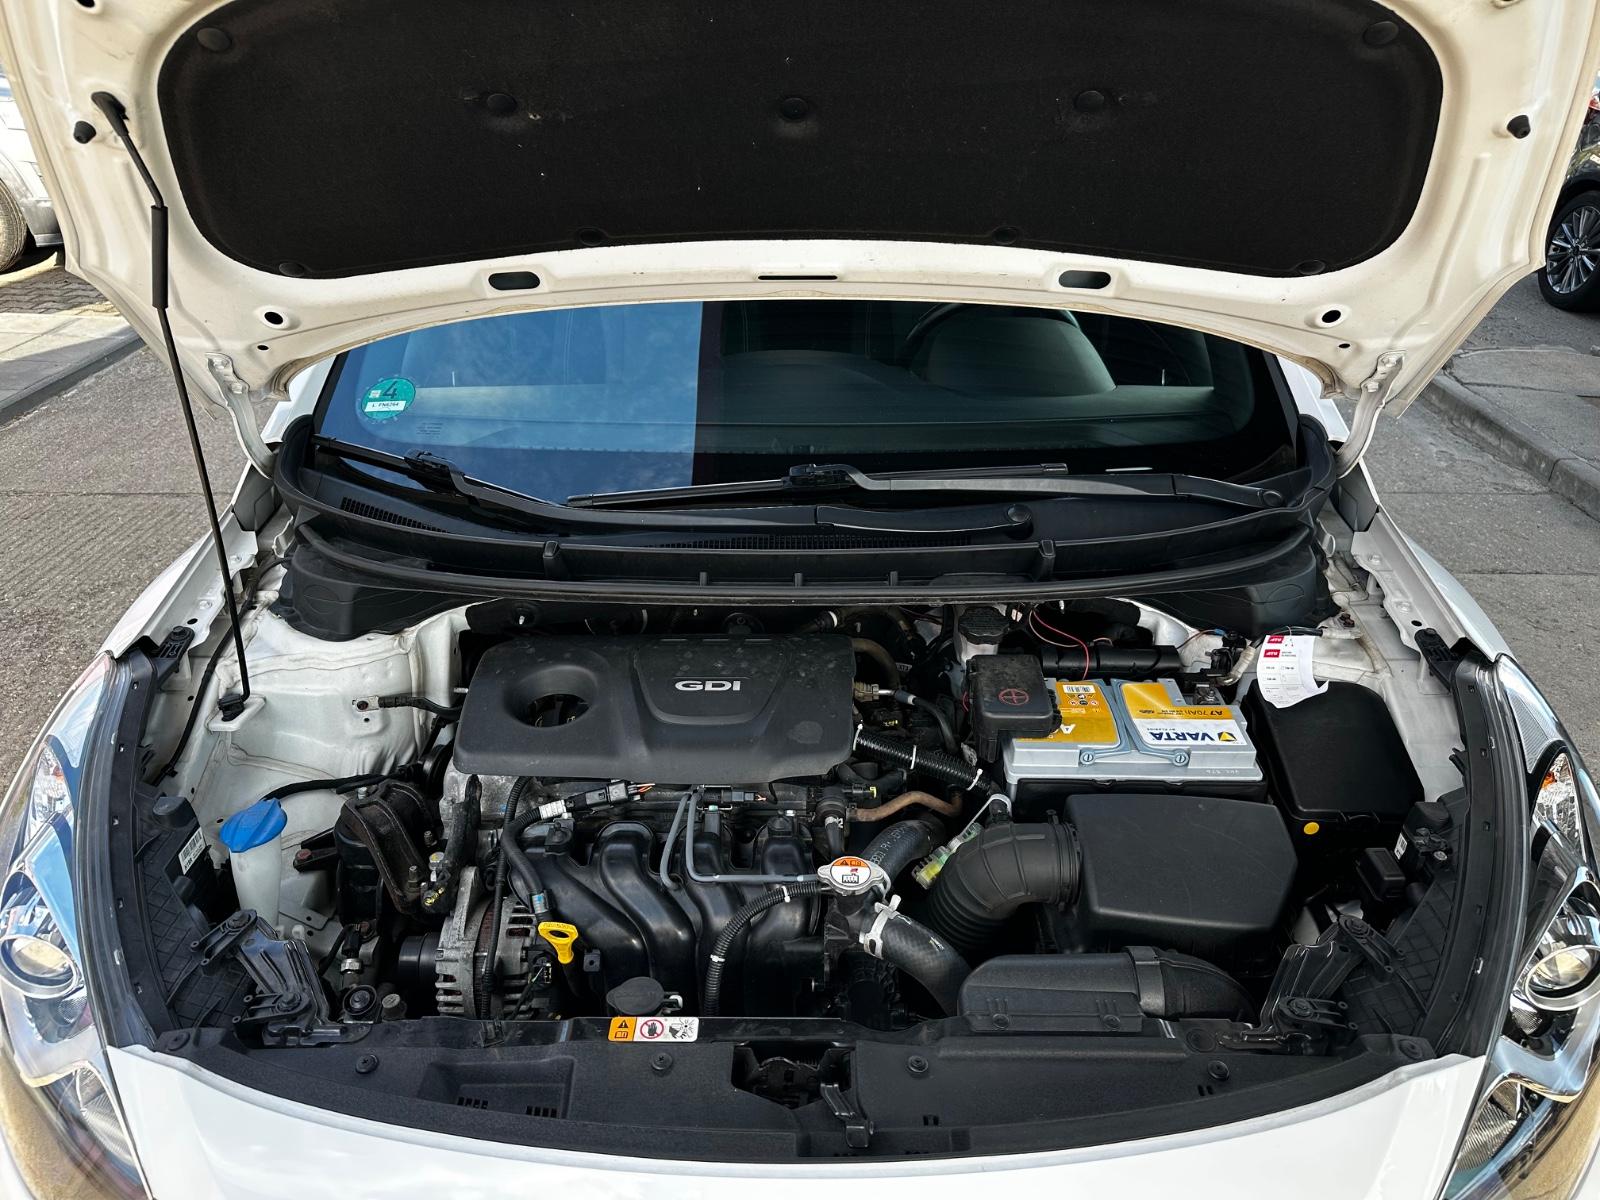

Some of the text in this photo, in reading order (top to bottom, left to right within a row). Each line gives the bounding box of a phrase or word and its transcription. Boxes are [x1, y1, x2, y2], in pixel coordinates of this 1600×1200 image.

[383, 380, 398, 399] 4
[675, 680, 741, 691] GDI
[1149, 732, 1215, 741] VARTA
